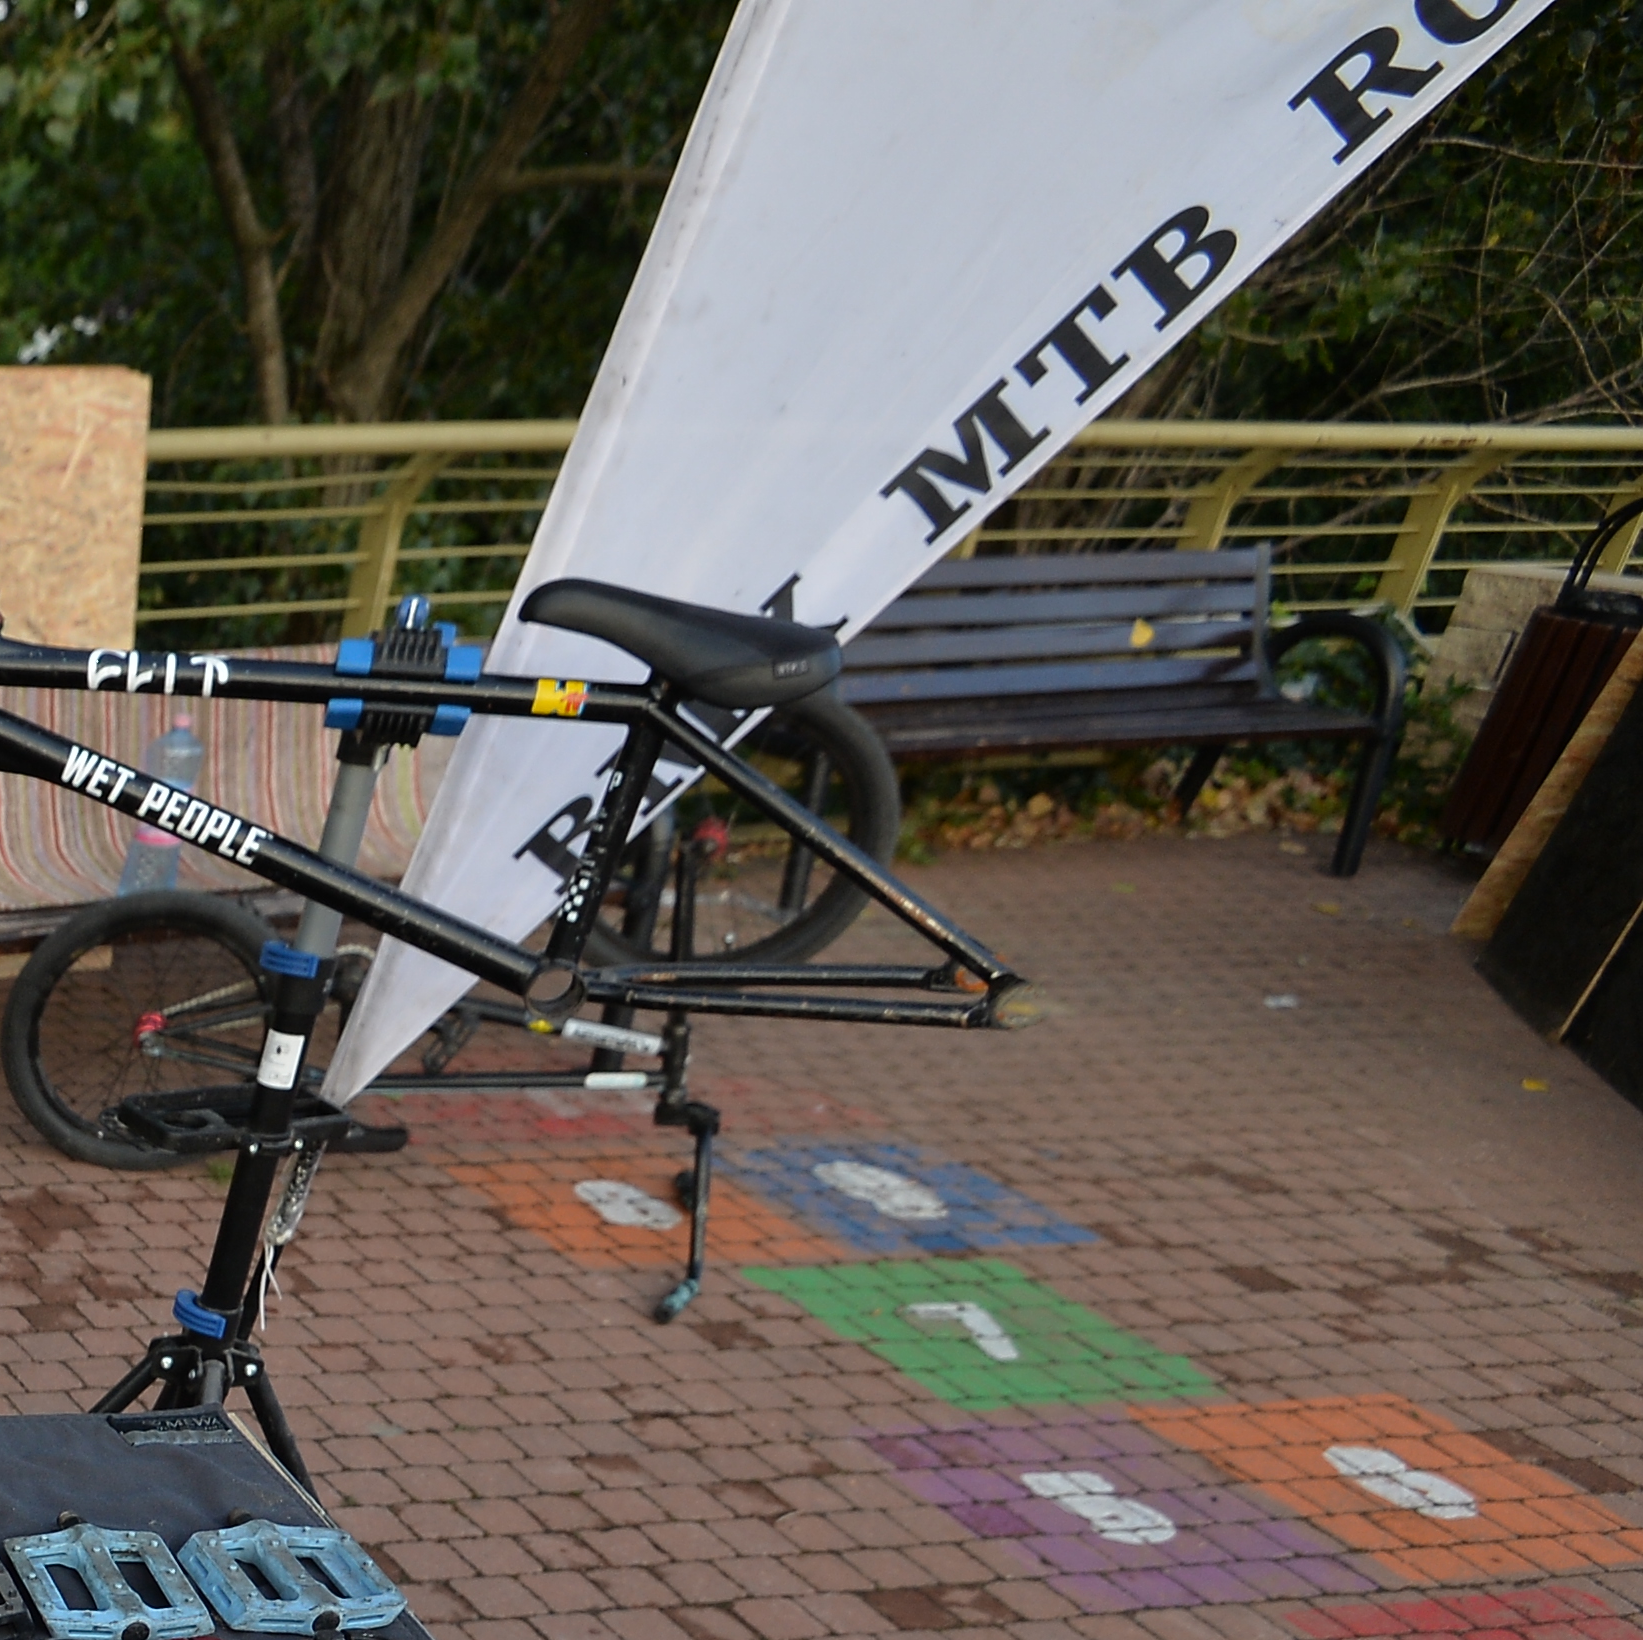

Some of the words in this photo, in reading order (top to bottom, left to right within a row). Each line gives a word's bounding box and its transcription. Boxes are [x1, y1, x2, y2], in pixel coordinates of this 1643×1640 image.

[880, 205, 1238, 545] MTB
[61, 745, 135, 803] WET
[137, 782, 269, 866] PEOPLE
